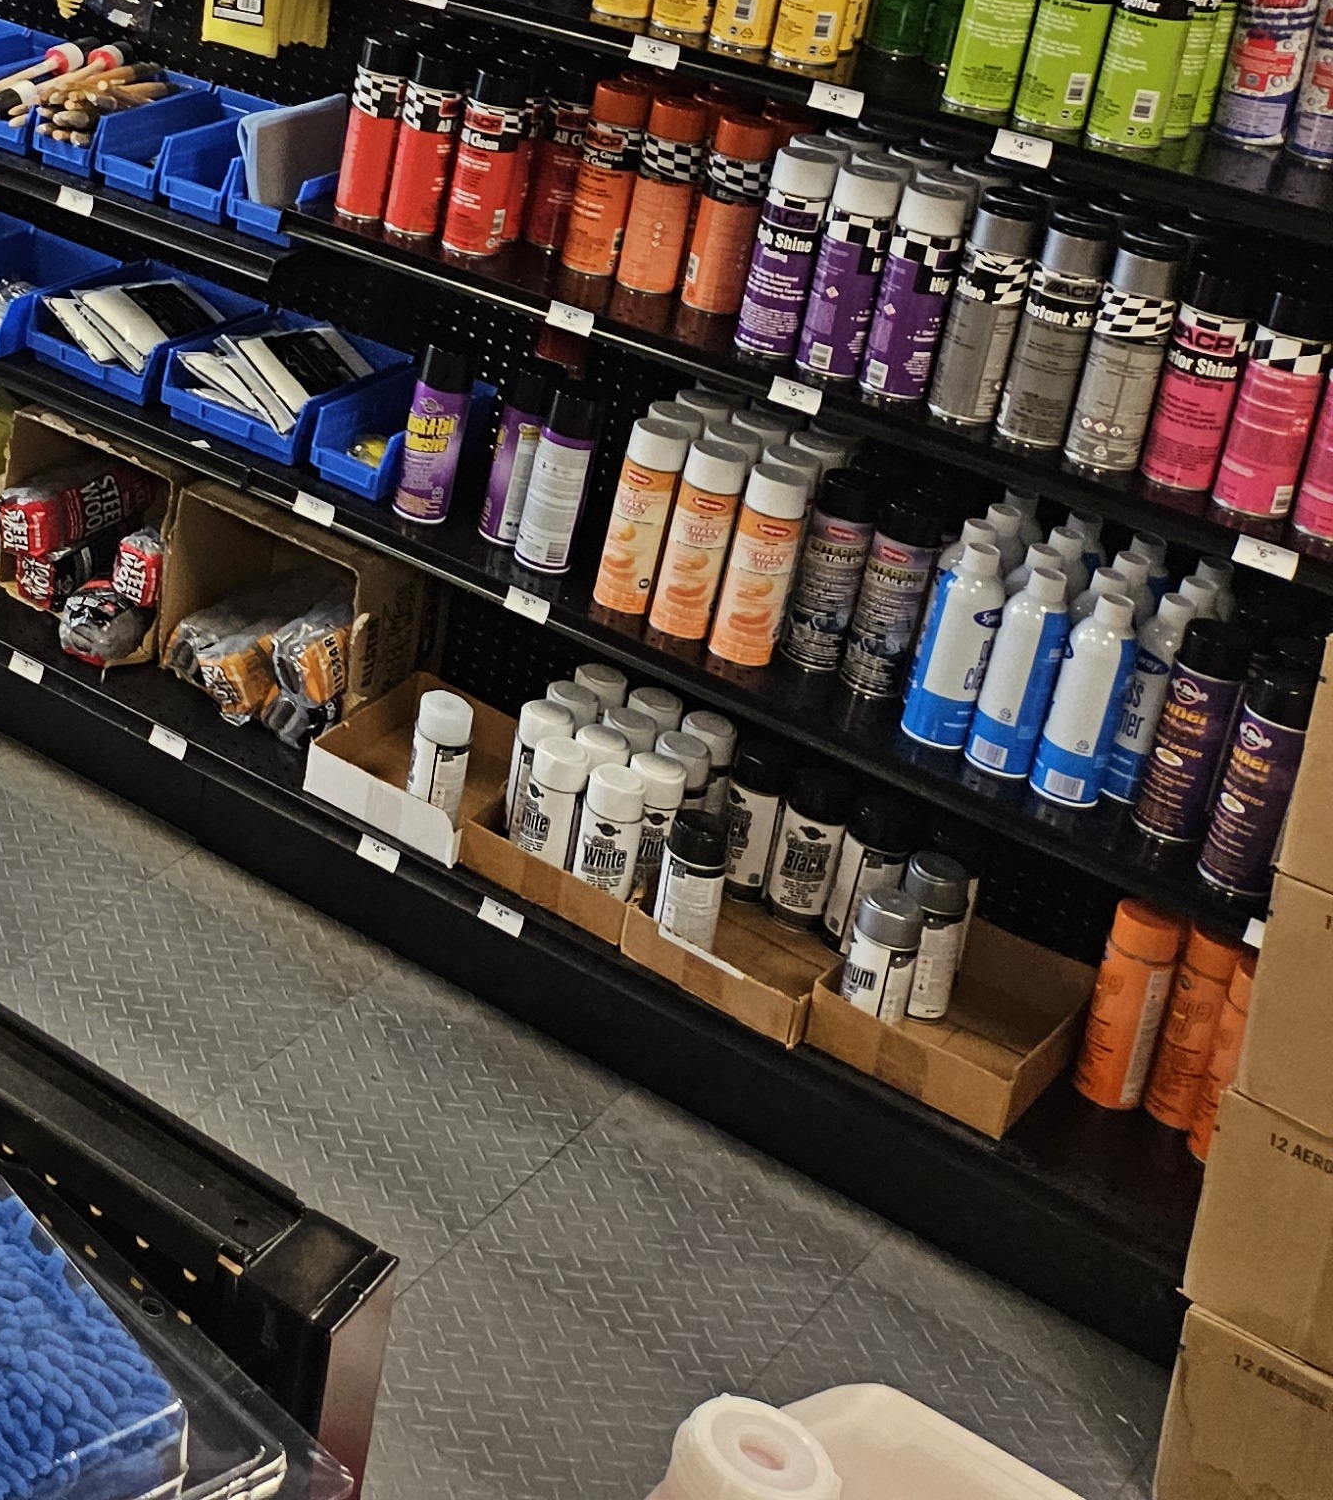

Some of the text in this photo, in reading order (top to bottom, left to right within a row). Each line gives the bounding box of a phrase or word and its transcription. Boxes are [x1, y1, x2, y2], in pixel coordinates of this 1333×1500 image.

[470, 133, 501, 152] Clean
[774, 231, 814, 254] Shine
[929, 276, 950, 296] Hig
[957, 274, 987, 302] Shine
[1057, 281, 1100, 299] ACP
[1179, 329, 1235, 354] ACP
[1195, 357, 1239, 380] Shine
[583, 845, 626, 869] White
[784, 849, 827, 873] Black
[1268, 1132, 1290, 1153] 12
[1233, 1352, 1256, 1374] 12
